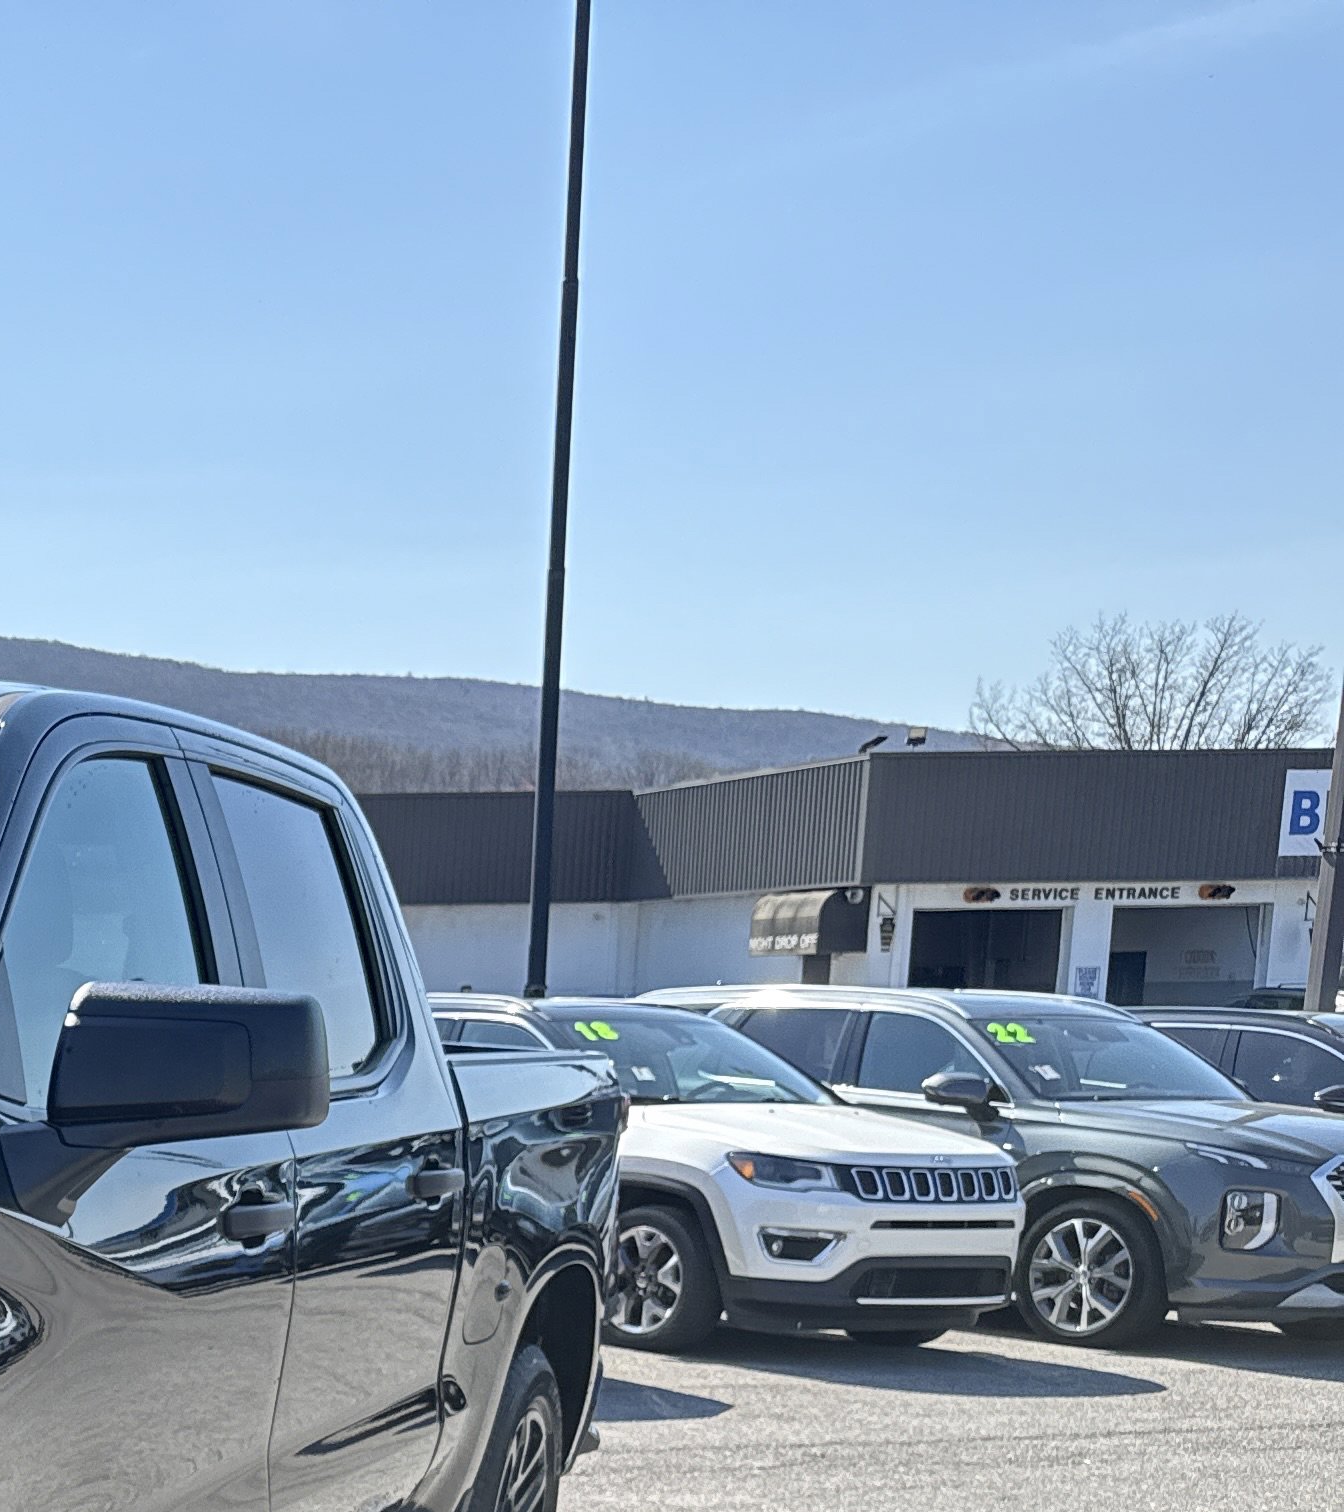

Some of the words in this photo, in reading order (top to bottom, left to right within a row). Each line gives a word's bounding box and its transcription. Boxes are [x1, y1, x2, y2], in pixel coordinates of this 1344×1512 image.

[1009, 887, 1081, 901] SERVICE
[1094, 886, 1181, 900] ENTRANCE
[775, 934, 799, 950] DROP
[800, 932, 819, 948] OFF
[987, 1022, 1036, 1044] 22
